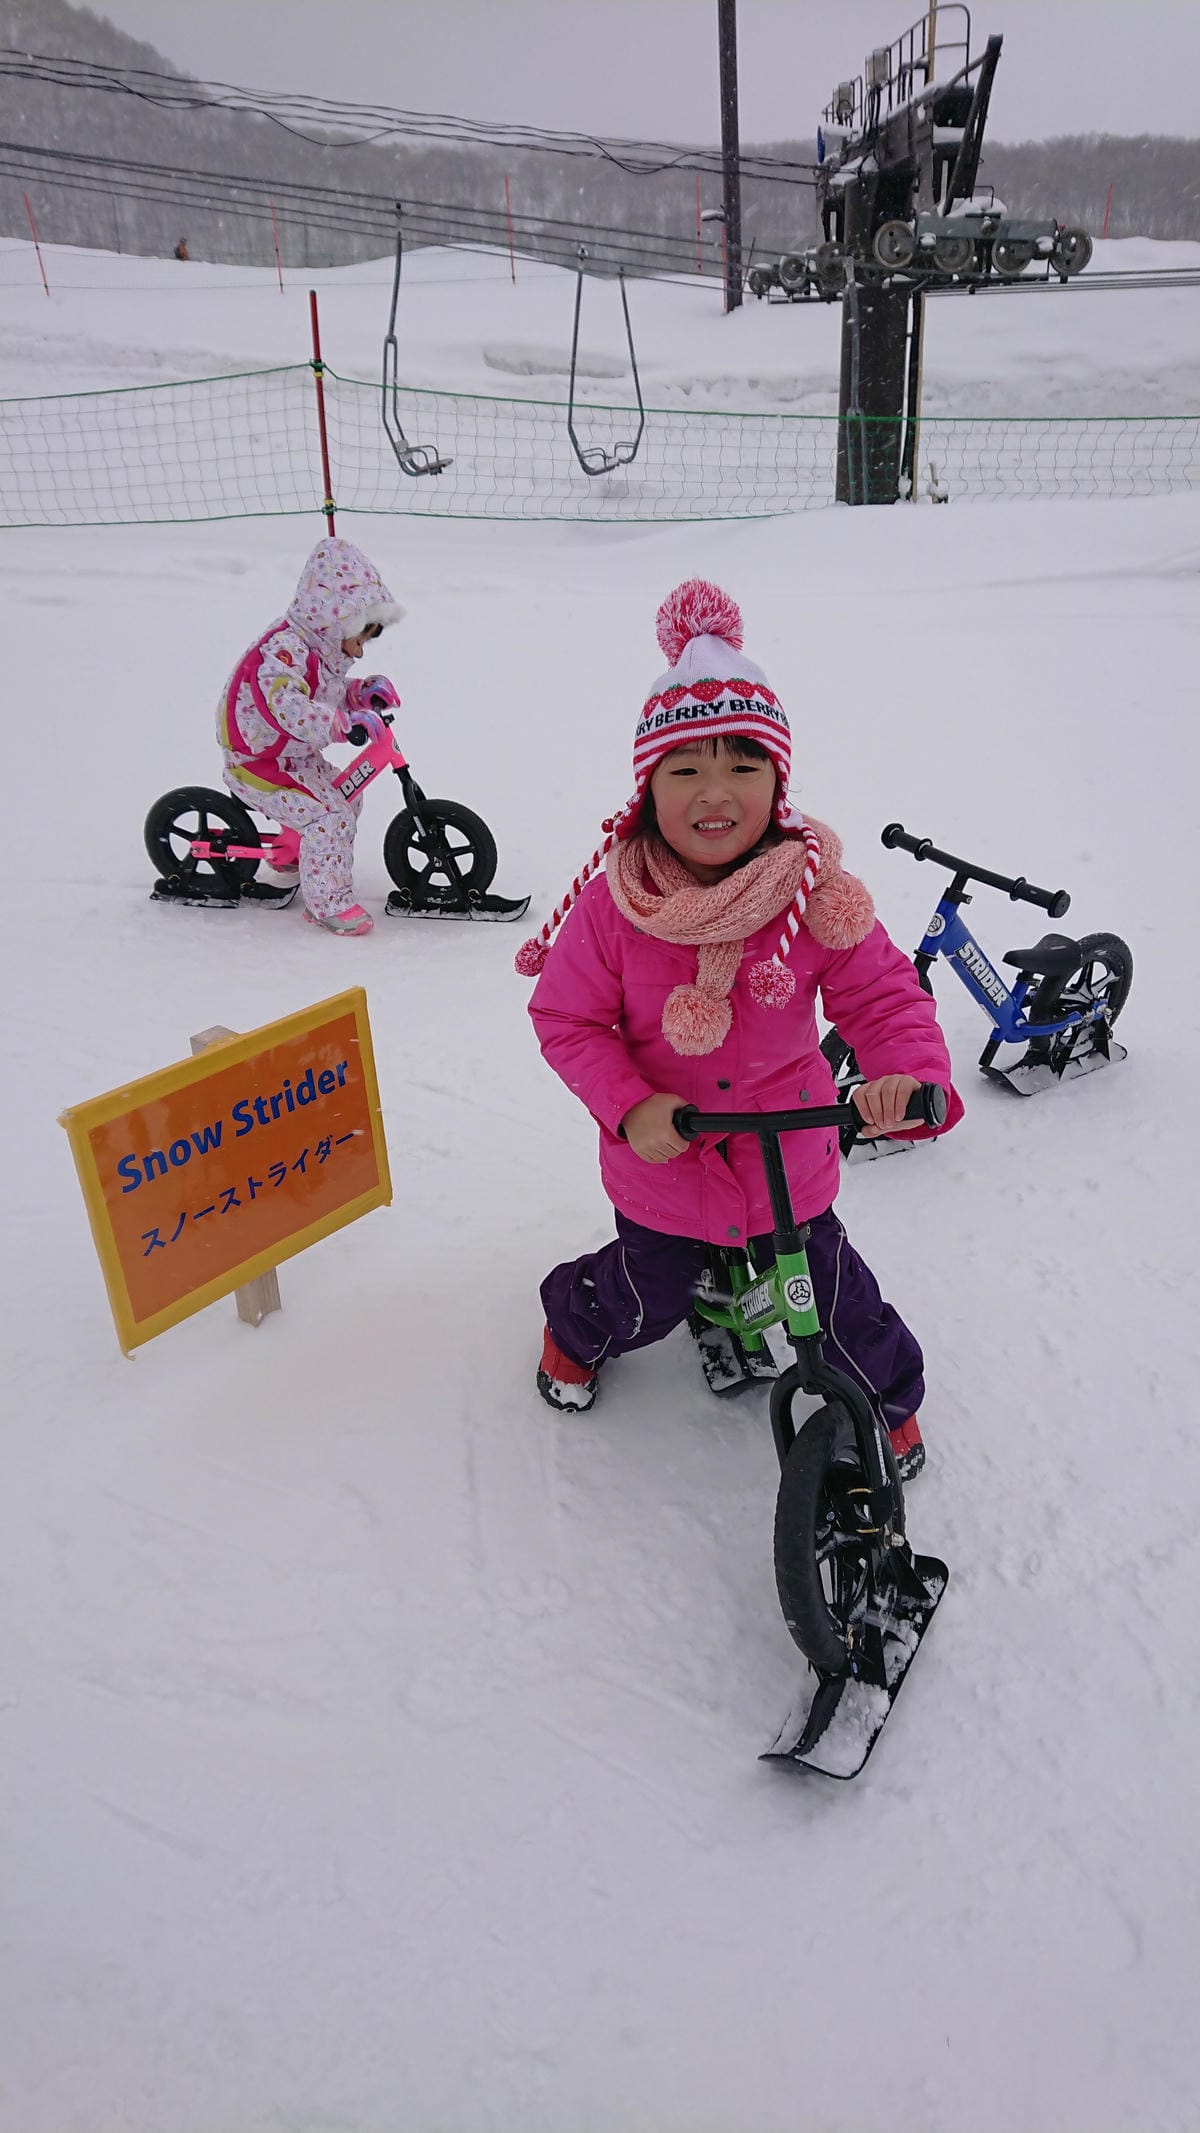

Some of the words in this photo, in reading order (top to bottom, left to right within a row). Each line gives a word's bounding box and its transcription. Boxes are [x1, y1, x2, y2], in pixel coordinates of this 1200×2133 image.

[655, 700, 725, 728] BERRY
[729, 699, 779, 721] BERRY
[339, 759, 376, 800] DER
[955, 941, 1008, 1008] STRIDER
[116, 1120, 223, 1194] Snow
[230, 1060, 349, 1137] Strider
[140, 1132, 355, 1257] スノーストライダー
[741, 1281, 775, 1324] STRIDER
